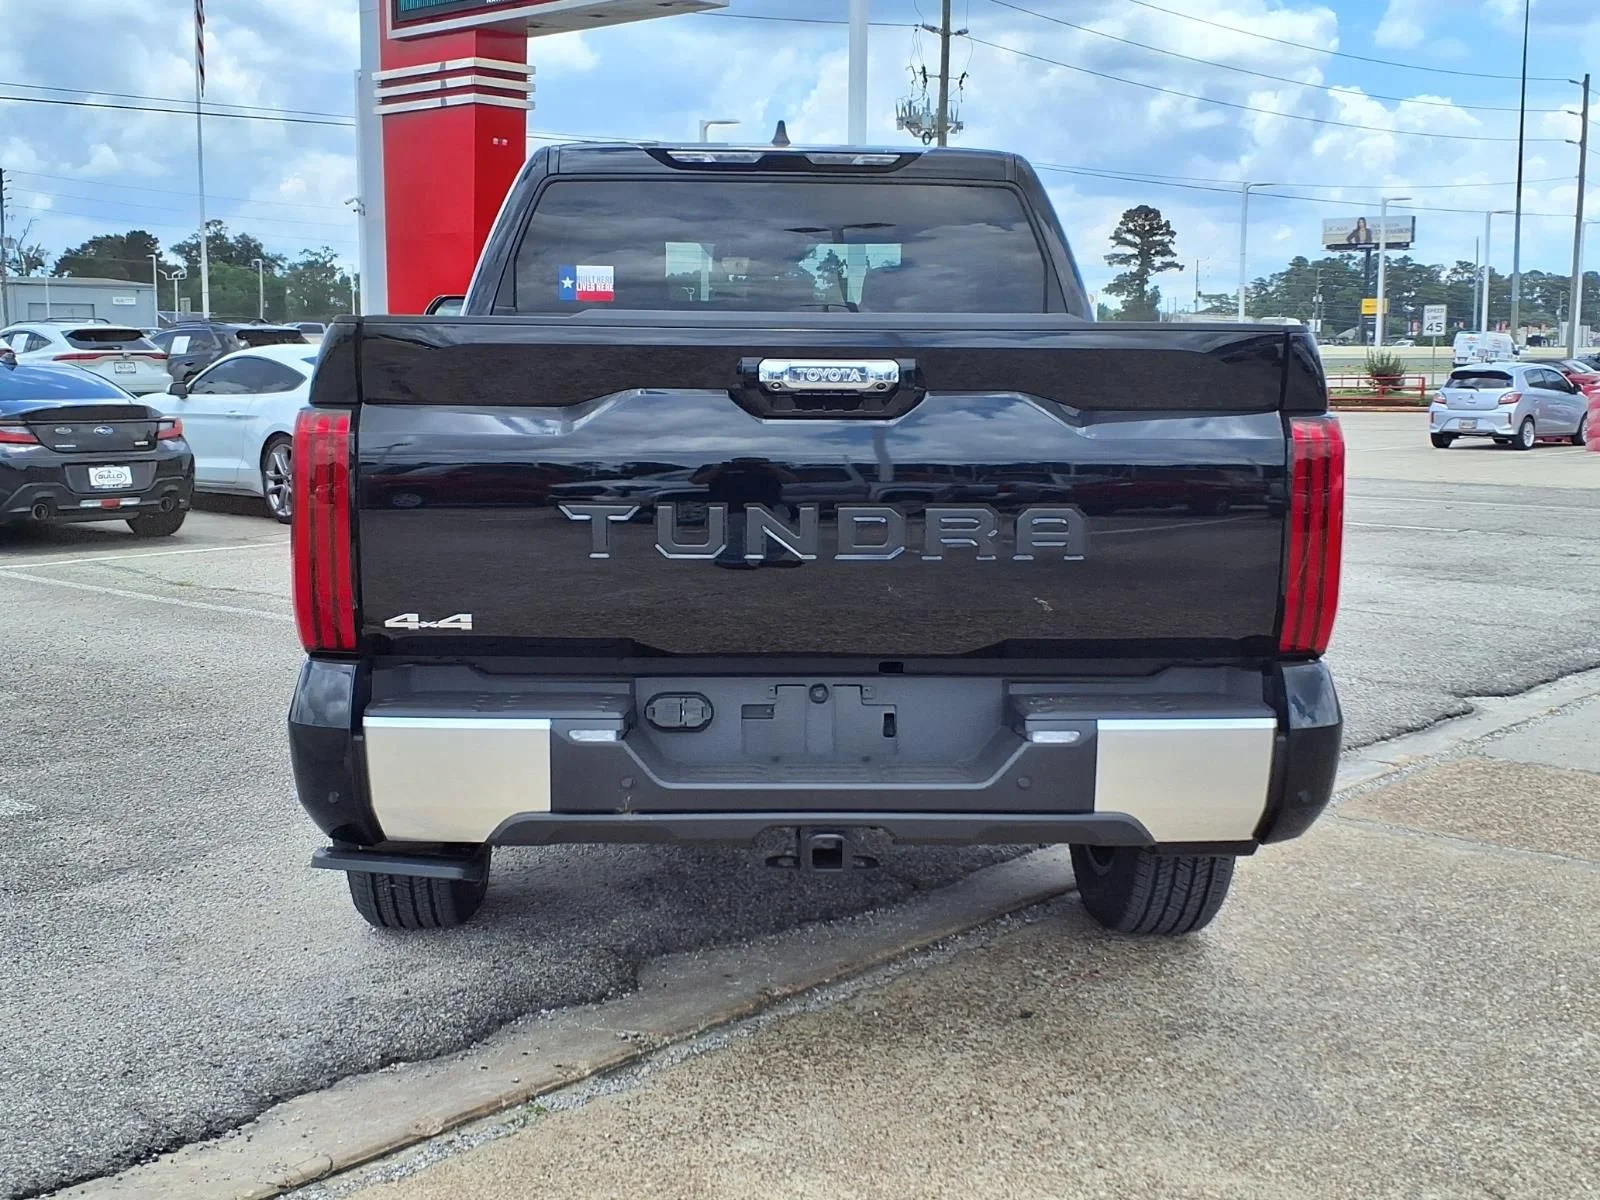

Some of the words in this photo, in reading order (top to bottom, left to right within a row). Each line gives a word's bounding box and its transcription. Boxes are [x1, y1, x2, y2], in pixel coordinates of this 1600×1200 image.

[577, 275, 595, 283] BUILT
[597, 275, 614, 283] HERE
[577, 283, 596, 292] LIVES
[596, 283, 614, 292] HERE
[1426, 322, 1443, 333] 45
[796, 367, 862, 382] TOYOTA
[558, 502, 1087, 562] TUNDRA
